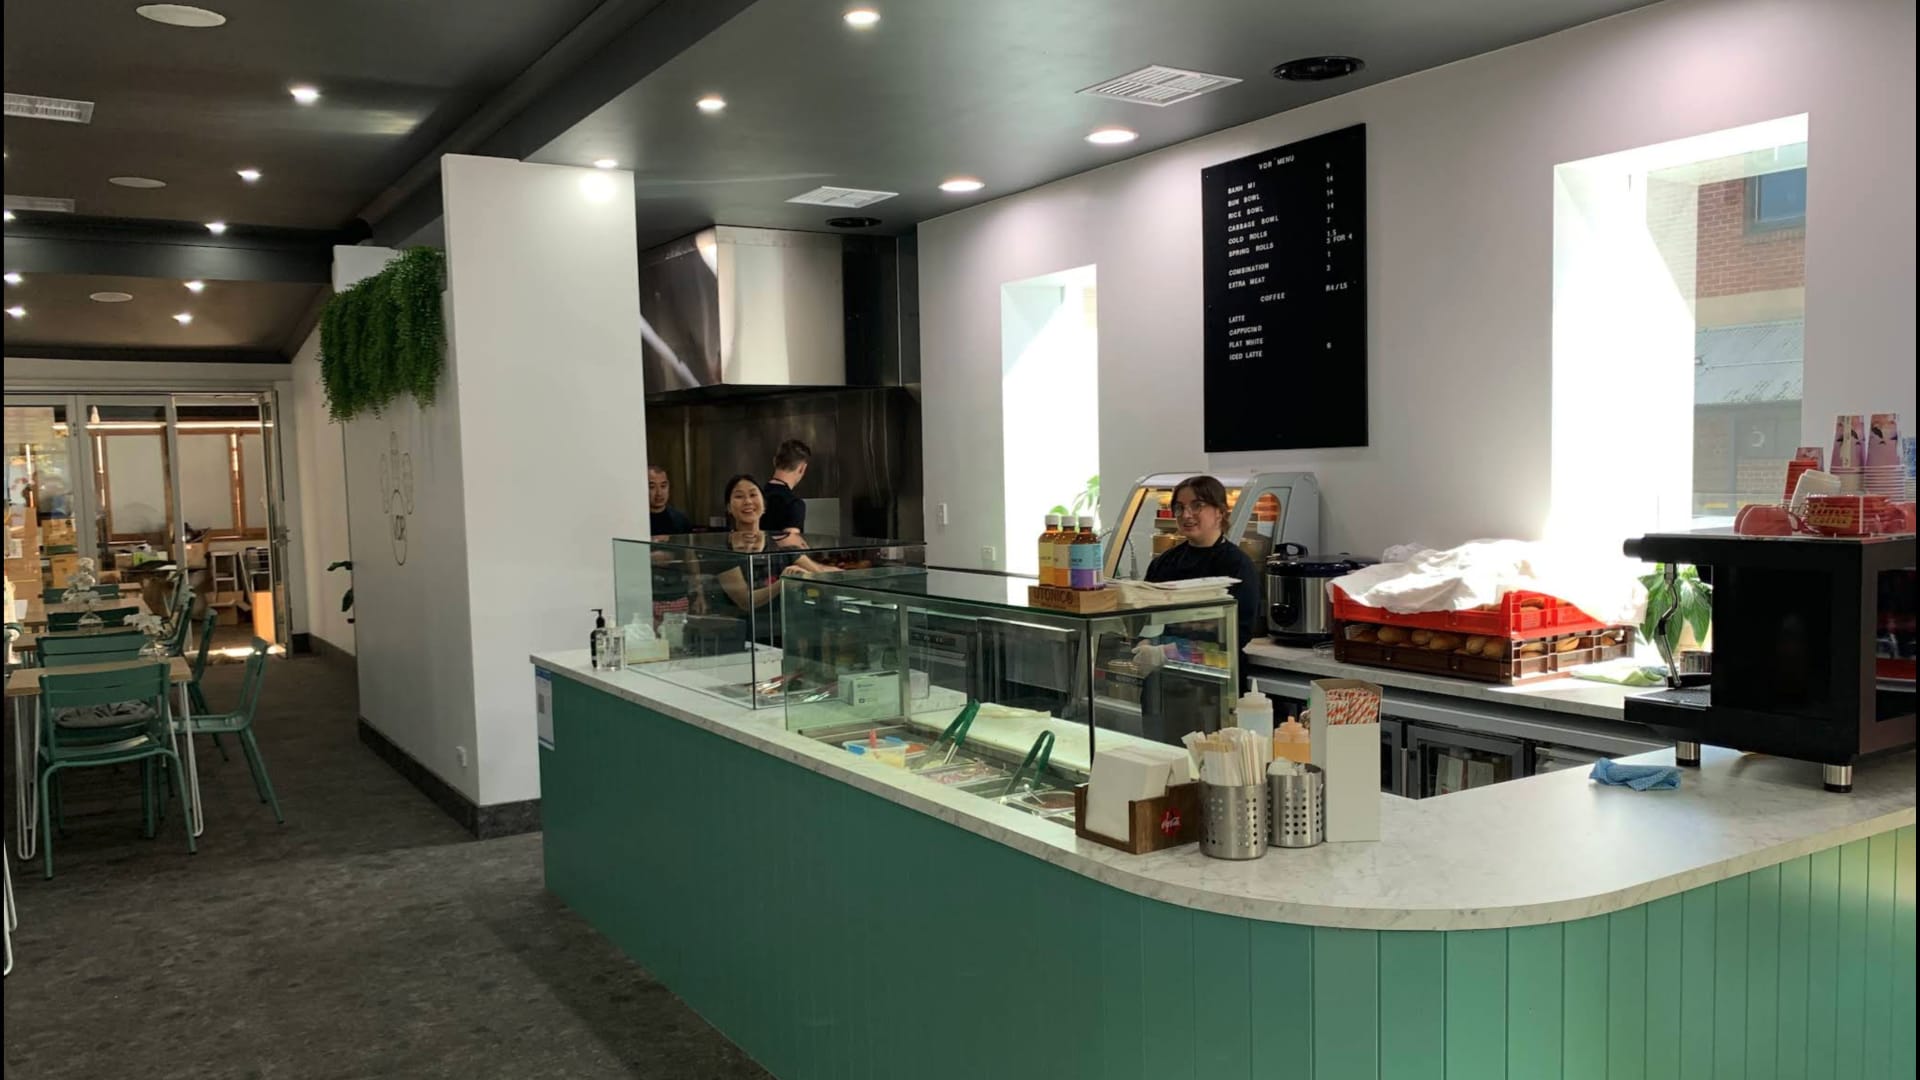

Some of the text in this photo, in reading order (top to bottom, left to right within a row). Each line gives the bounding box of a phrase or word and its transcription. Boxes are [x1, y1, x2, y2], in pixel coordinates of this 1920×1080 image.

[1277, 155, 1295, 165] MENU
[1228, 185, 1243, 194] BANH
[1244, 194, 1260, 203] BOWL
[1228, 206, 1264, 219] RICE BOWL
[1228, 216, 1279, 232] CABBAGE BOWL
[1228, 231, 1268, 245] COLD ROLLS
[1333, 235, 1346, 243] FOR
[1228, 242, 1274, 257] SPRING ROLLS
[1229, 263, 1269, 276] COMBINATION
[1228, 277, 1265, 289] EXTRA MEAT
[1260, 292, 1285, 302] COFFEE
[1229, 315, 1245, 323] LATTE
[1229, 338, 1264, 348] FLAT WHITE
[1229, 350, 1263, 361] ICED LATTE
